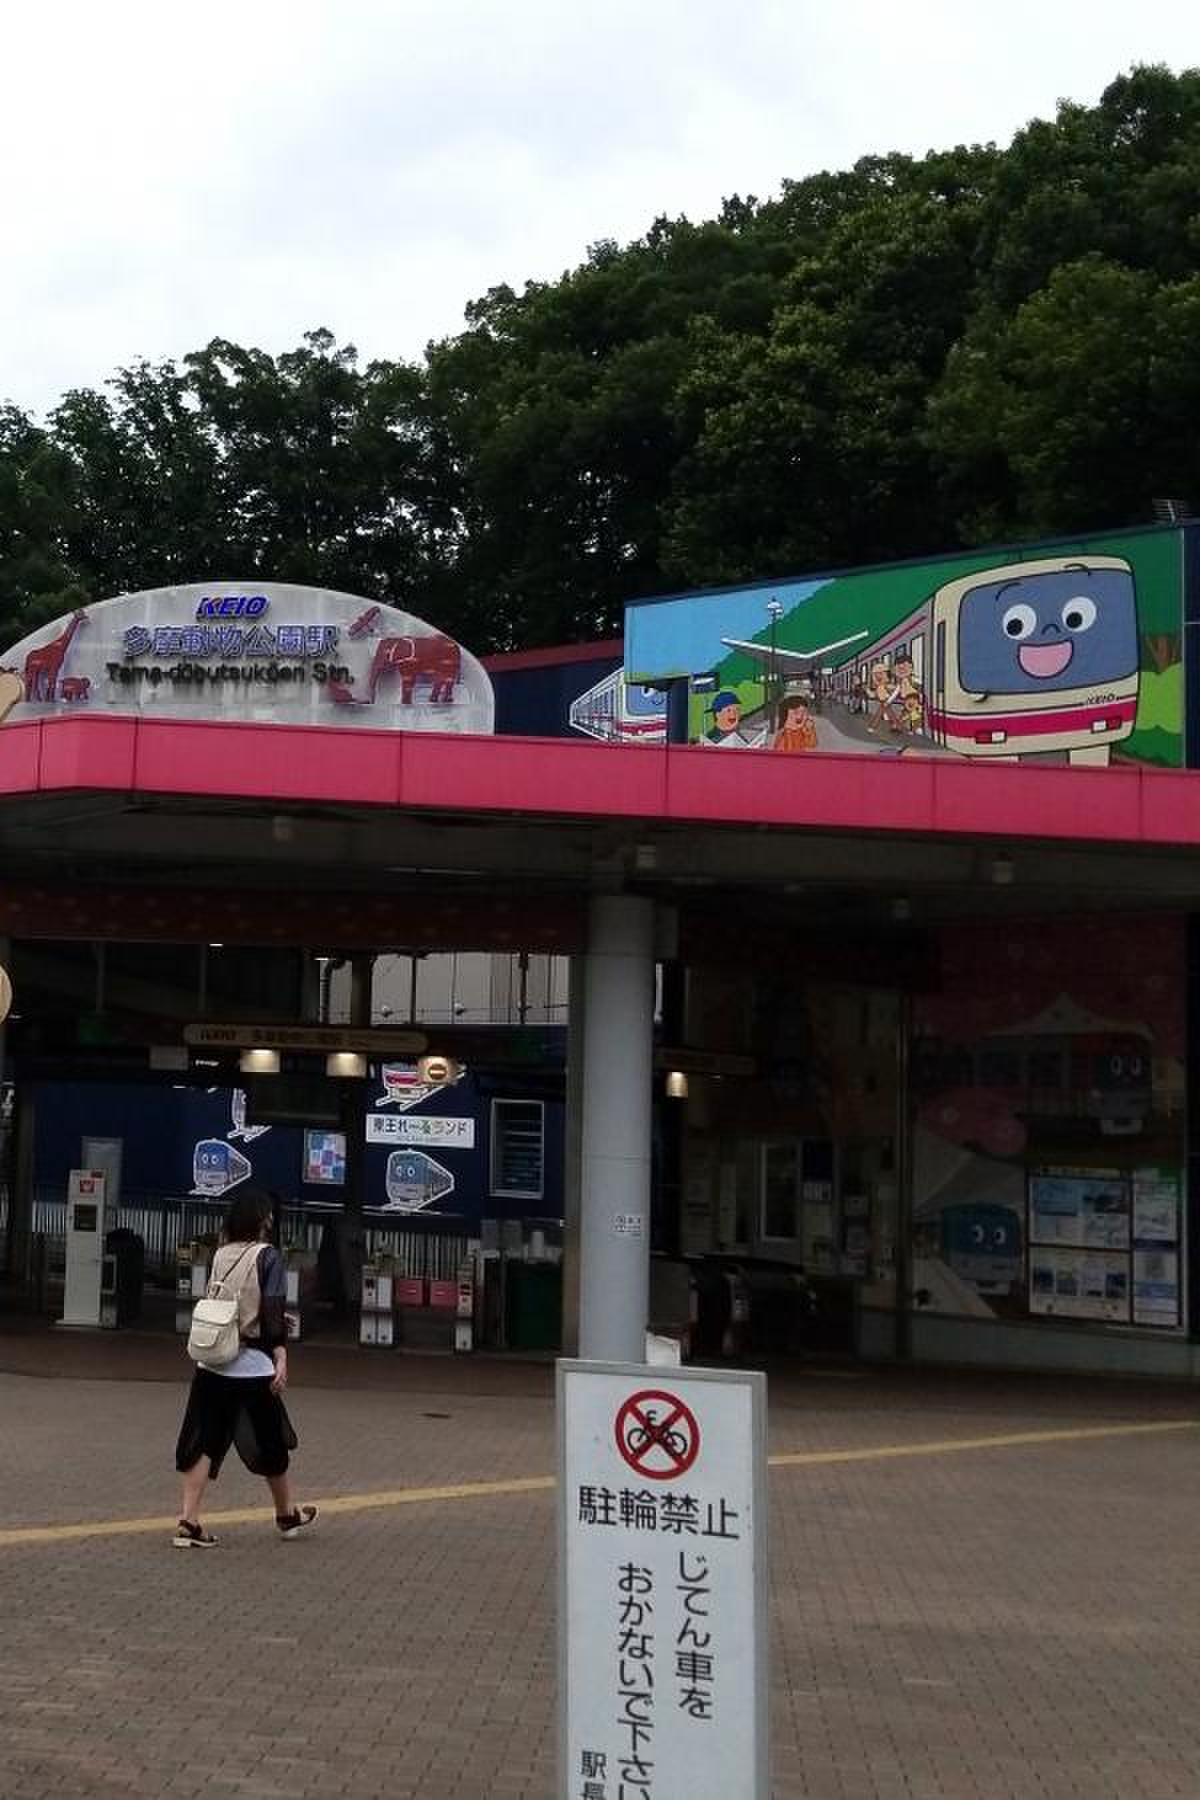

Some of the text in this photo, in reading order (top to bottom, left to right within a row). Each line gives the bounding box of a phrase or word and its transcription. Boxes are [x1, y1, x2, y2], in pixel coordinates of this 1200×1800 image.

[197, 597, 268, 619] KEIO
[124, 625, 338, 657] 多摩動物公園駅
[578, 1485, 741, 1541] 駐輪禁止
[674, 1551, 715, 1720] じてん車を
[616, 1562, 655, 1800] おかないで下さい
